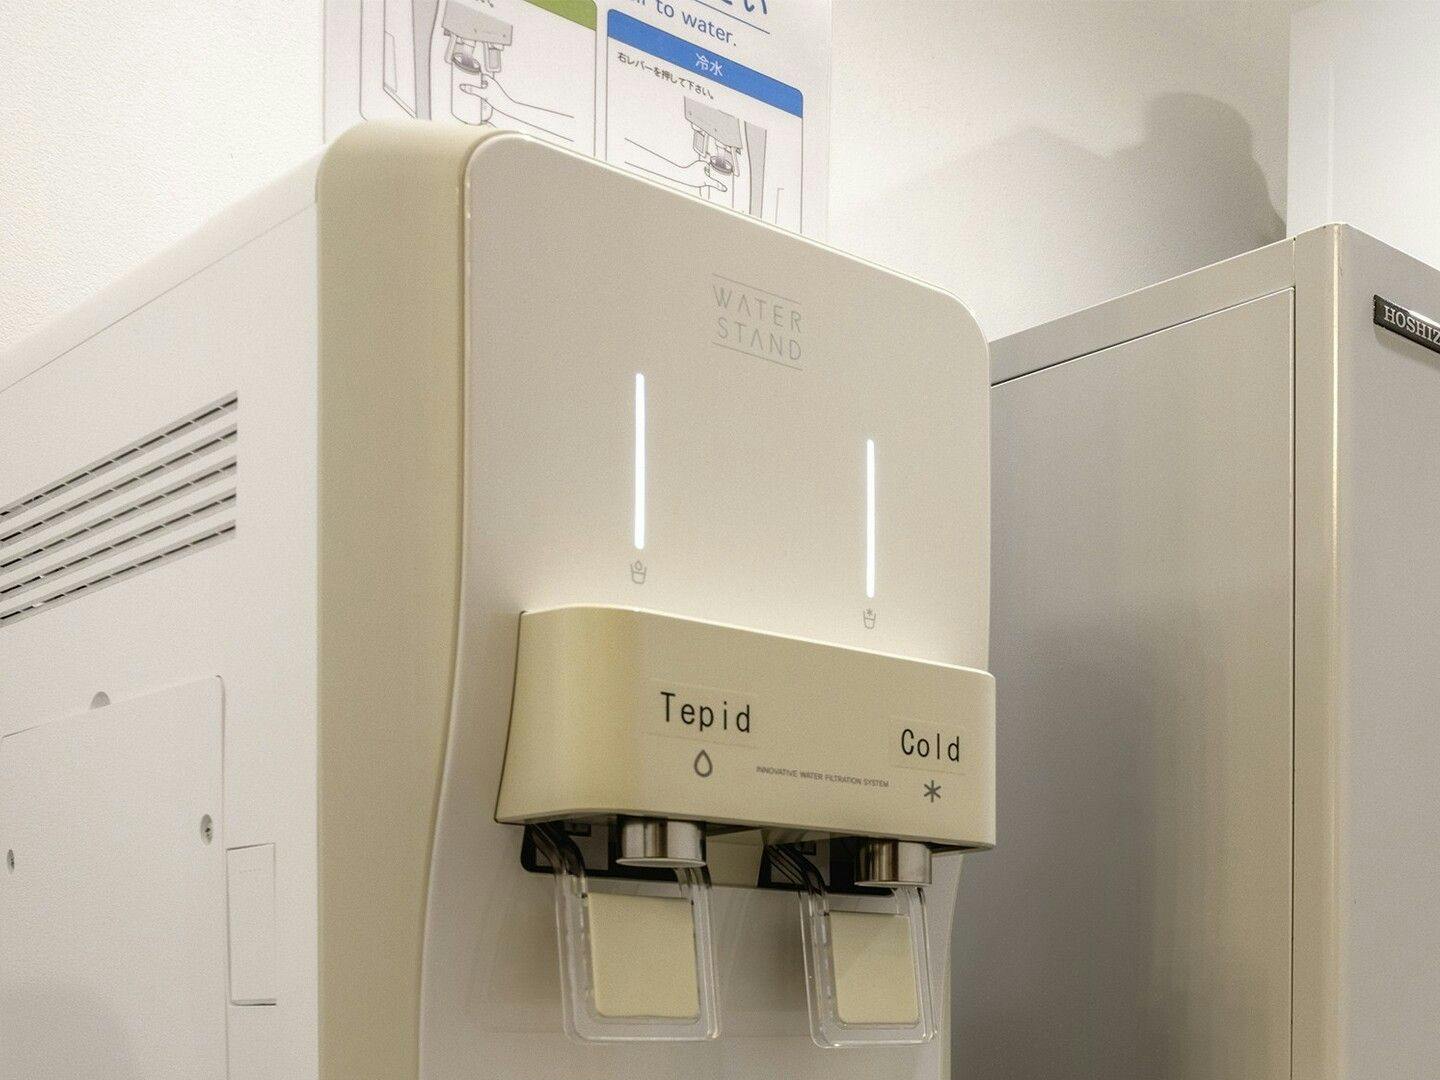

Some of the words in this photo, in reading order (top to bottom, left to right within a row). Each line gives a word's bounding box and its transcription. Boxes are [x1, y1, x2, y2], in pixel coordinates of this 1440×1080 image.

[656, 1, 675, 17] to
[682, 11, 737, 46] water.
[695, 53, 724, 77] 冷水
[713, 285, 801, 333] WATER
[719, 317, 801, 360] STAND
[660, 690, 751, 733] Tepid
[900, 728, 961, 763] Cold
[756, 766, 798, 778] INNOVATIVE
[800, 772, 823, 780] WATER
[825, 774, 861, 785] FILTRATION
[863, 778, 889, 788] SYSTEM
